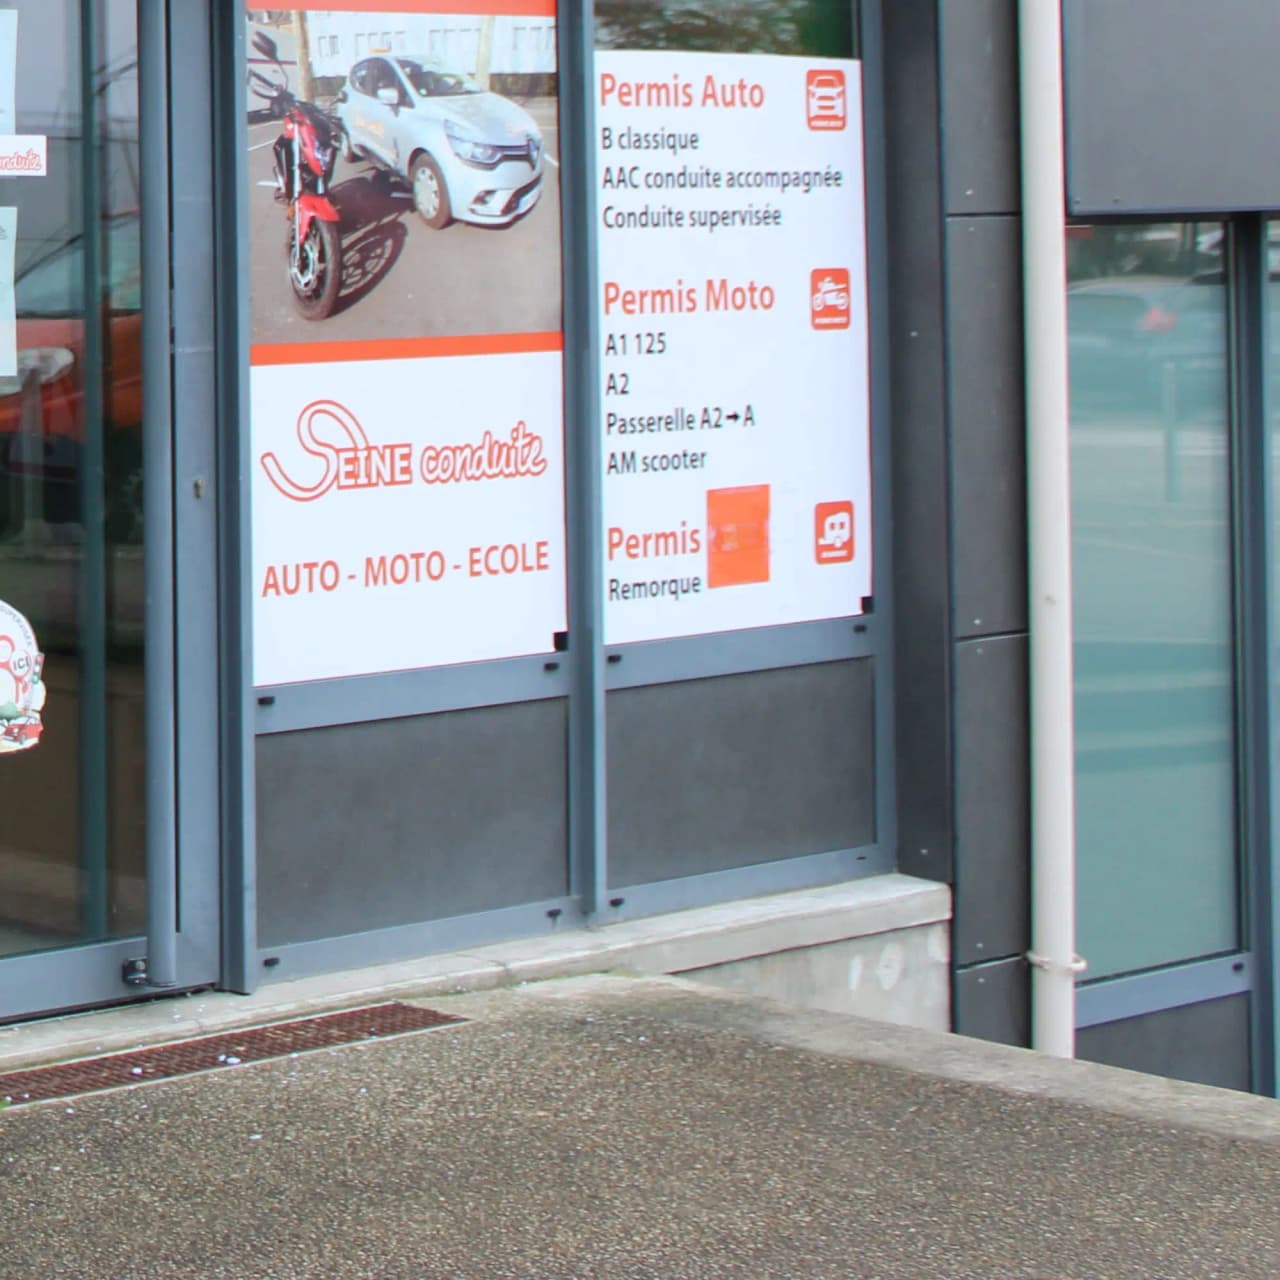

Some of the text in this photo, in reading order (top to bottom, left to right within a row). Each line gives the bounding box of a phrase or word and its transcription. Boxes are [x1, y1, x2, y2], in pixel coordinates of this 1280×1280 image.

[600, 73, 765, 108] Permis Auto
[601, 125, 700, 156] B classique
[602, 164, 843, 194] AAC conduite accompagnée
[602, 202, 782, 233] Conduite supervisée
[604, 278, 775, 315] Permis Moto
[605, 332, 667, 356] A1 125
[606, 373, 630, 396] A2
[606, 405, 756, 435] Passerelle A2 A
[260, 399, 548, 502] SEINE conduite
[607, 449, 707, 475] AM scooter
[608, 520, 701, 561] Permis
[261, 560, 340, 598] AUTO
[364, 550, 446, 587] MOTO
[469, 540, 549, 578] ECOLE
[609, 576, 702, 602] Remorque
[12, 656, 30, 671] ICI
